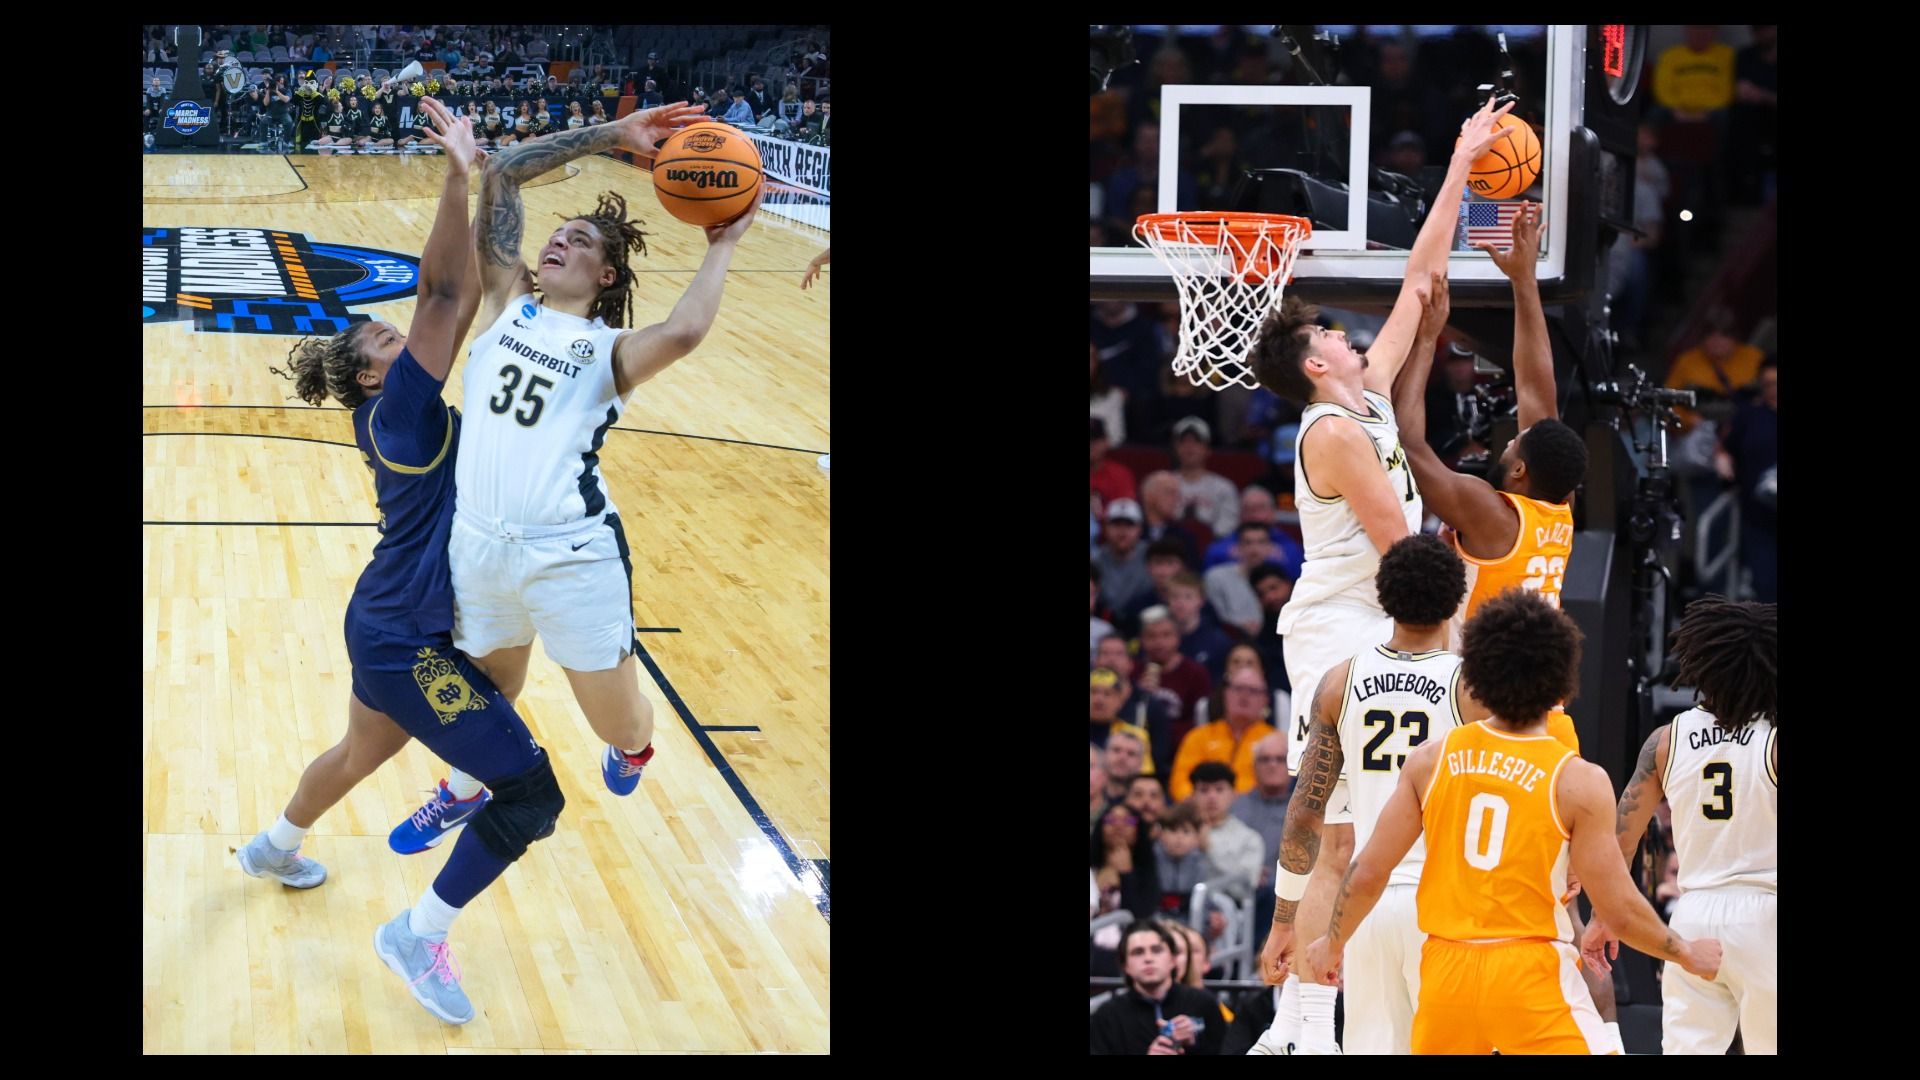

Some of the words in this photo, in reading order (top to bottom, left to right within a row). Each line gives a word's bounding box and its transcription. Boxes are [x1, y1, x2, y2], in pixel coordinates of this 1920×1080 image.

[666, 168, 739, 189] Wilson
[795, 147, 831, 192] REGI
[180, 228, 288, 296] MADNESS
[498, 333, 582, 379] VANDERBILT
[489, 364, 554, 427] 35
[1353, 672, 1446, 706] LENDEBORG
[1362, 709, 1430, 772] 23
[1447, 749, 1546, 793] GILLESPIE
[1702, 762, 1733, 820] 3
[1463, 791, 1510, 872] 0
